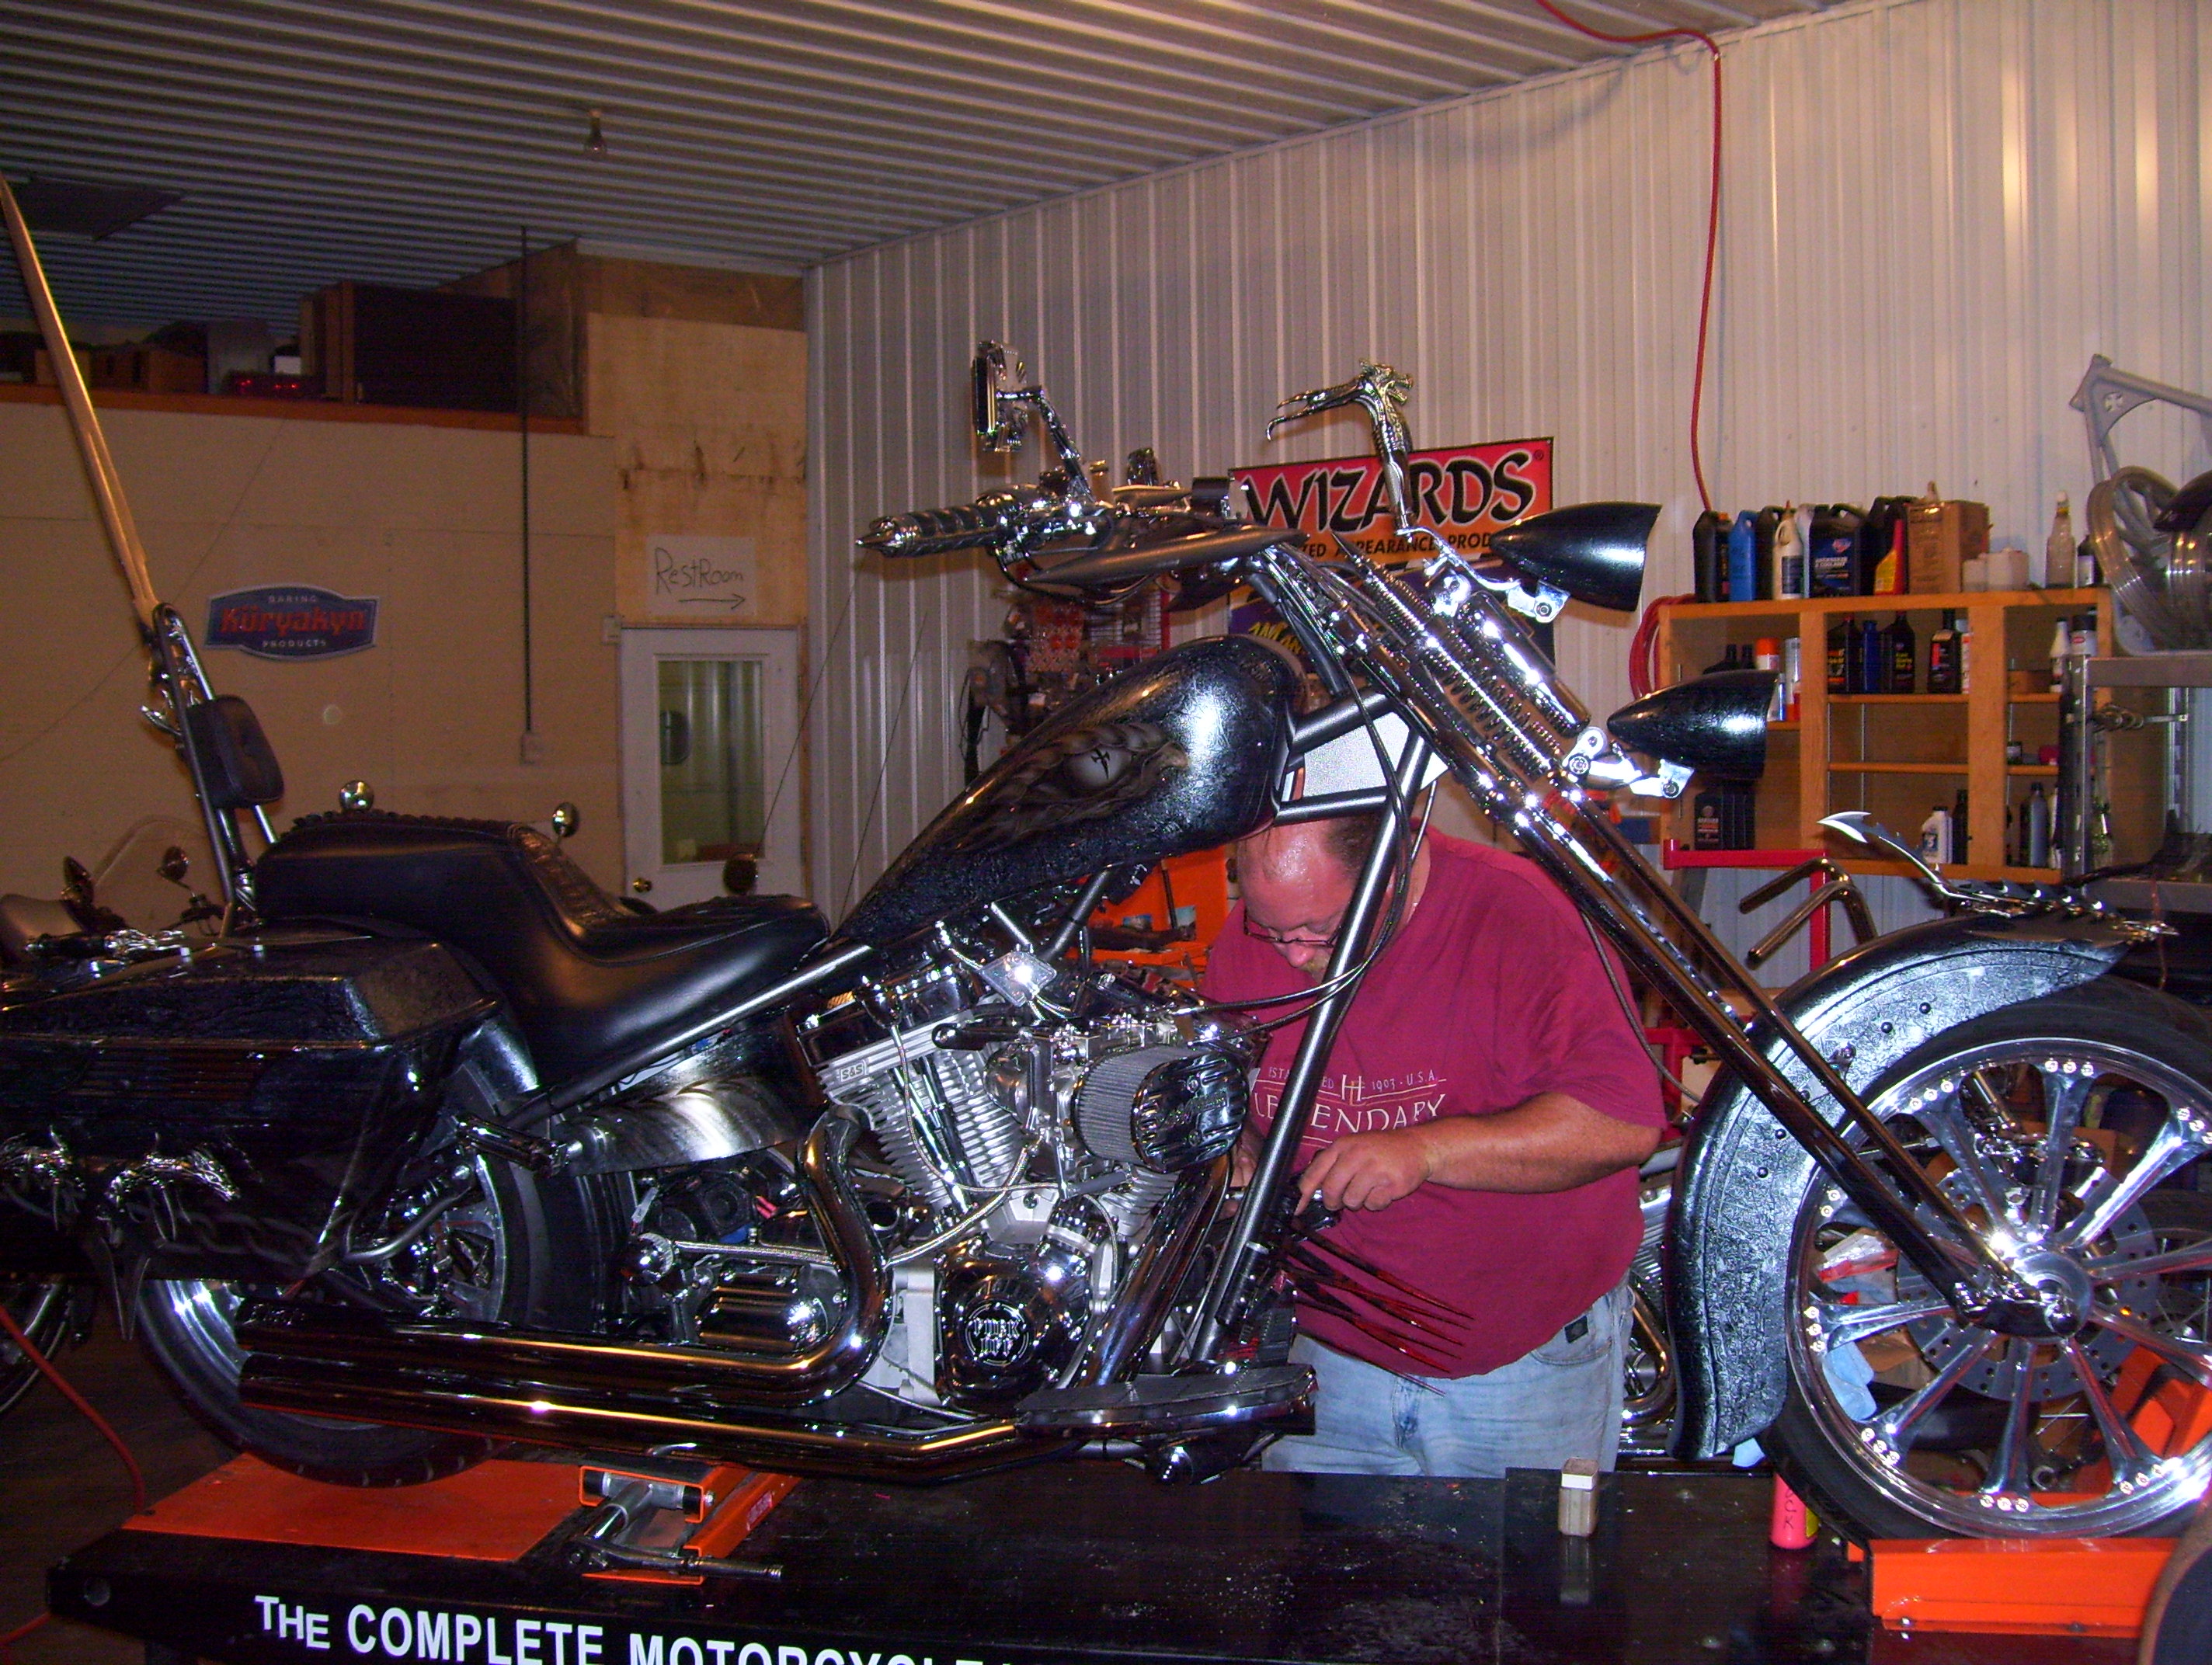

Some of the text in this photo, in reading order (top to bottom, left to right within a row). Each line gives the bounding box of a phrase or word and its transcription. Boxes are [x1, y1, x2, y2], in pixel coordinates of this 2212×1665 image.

[1243, 452, 1534, 533] WIZARDS
[1335, 536, 1436, 557] PEARANCE
[267, 595, 317, 604] DARING
[219, 604, 366, 637] Küryakyn
[262, 638, 327, 648] PRODUCTS
[841, 1063, 863, 1080] S&S
[1253, 1092, 1445, 1133] LEENDARY
[253, 1594, 332, 1649] THE
[347, 1604, 603, 1665] COMPLETE
